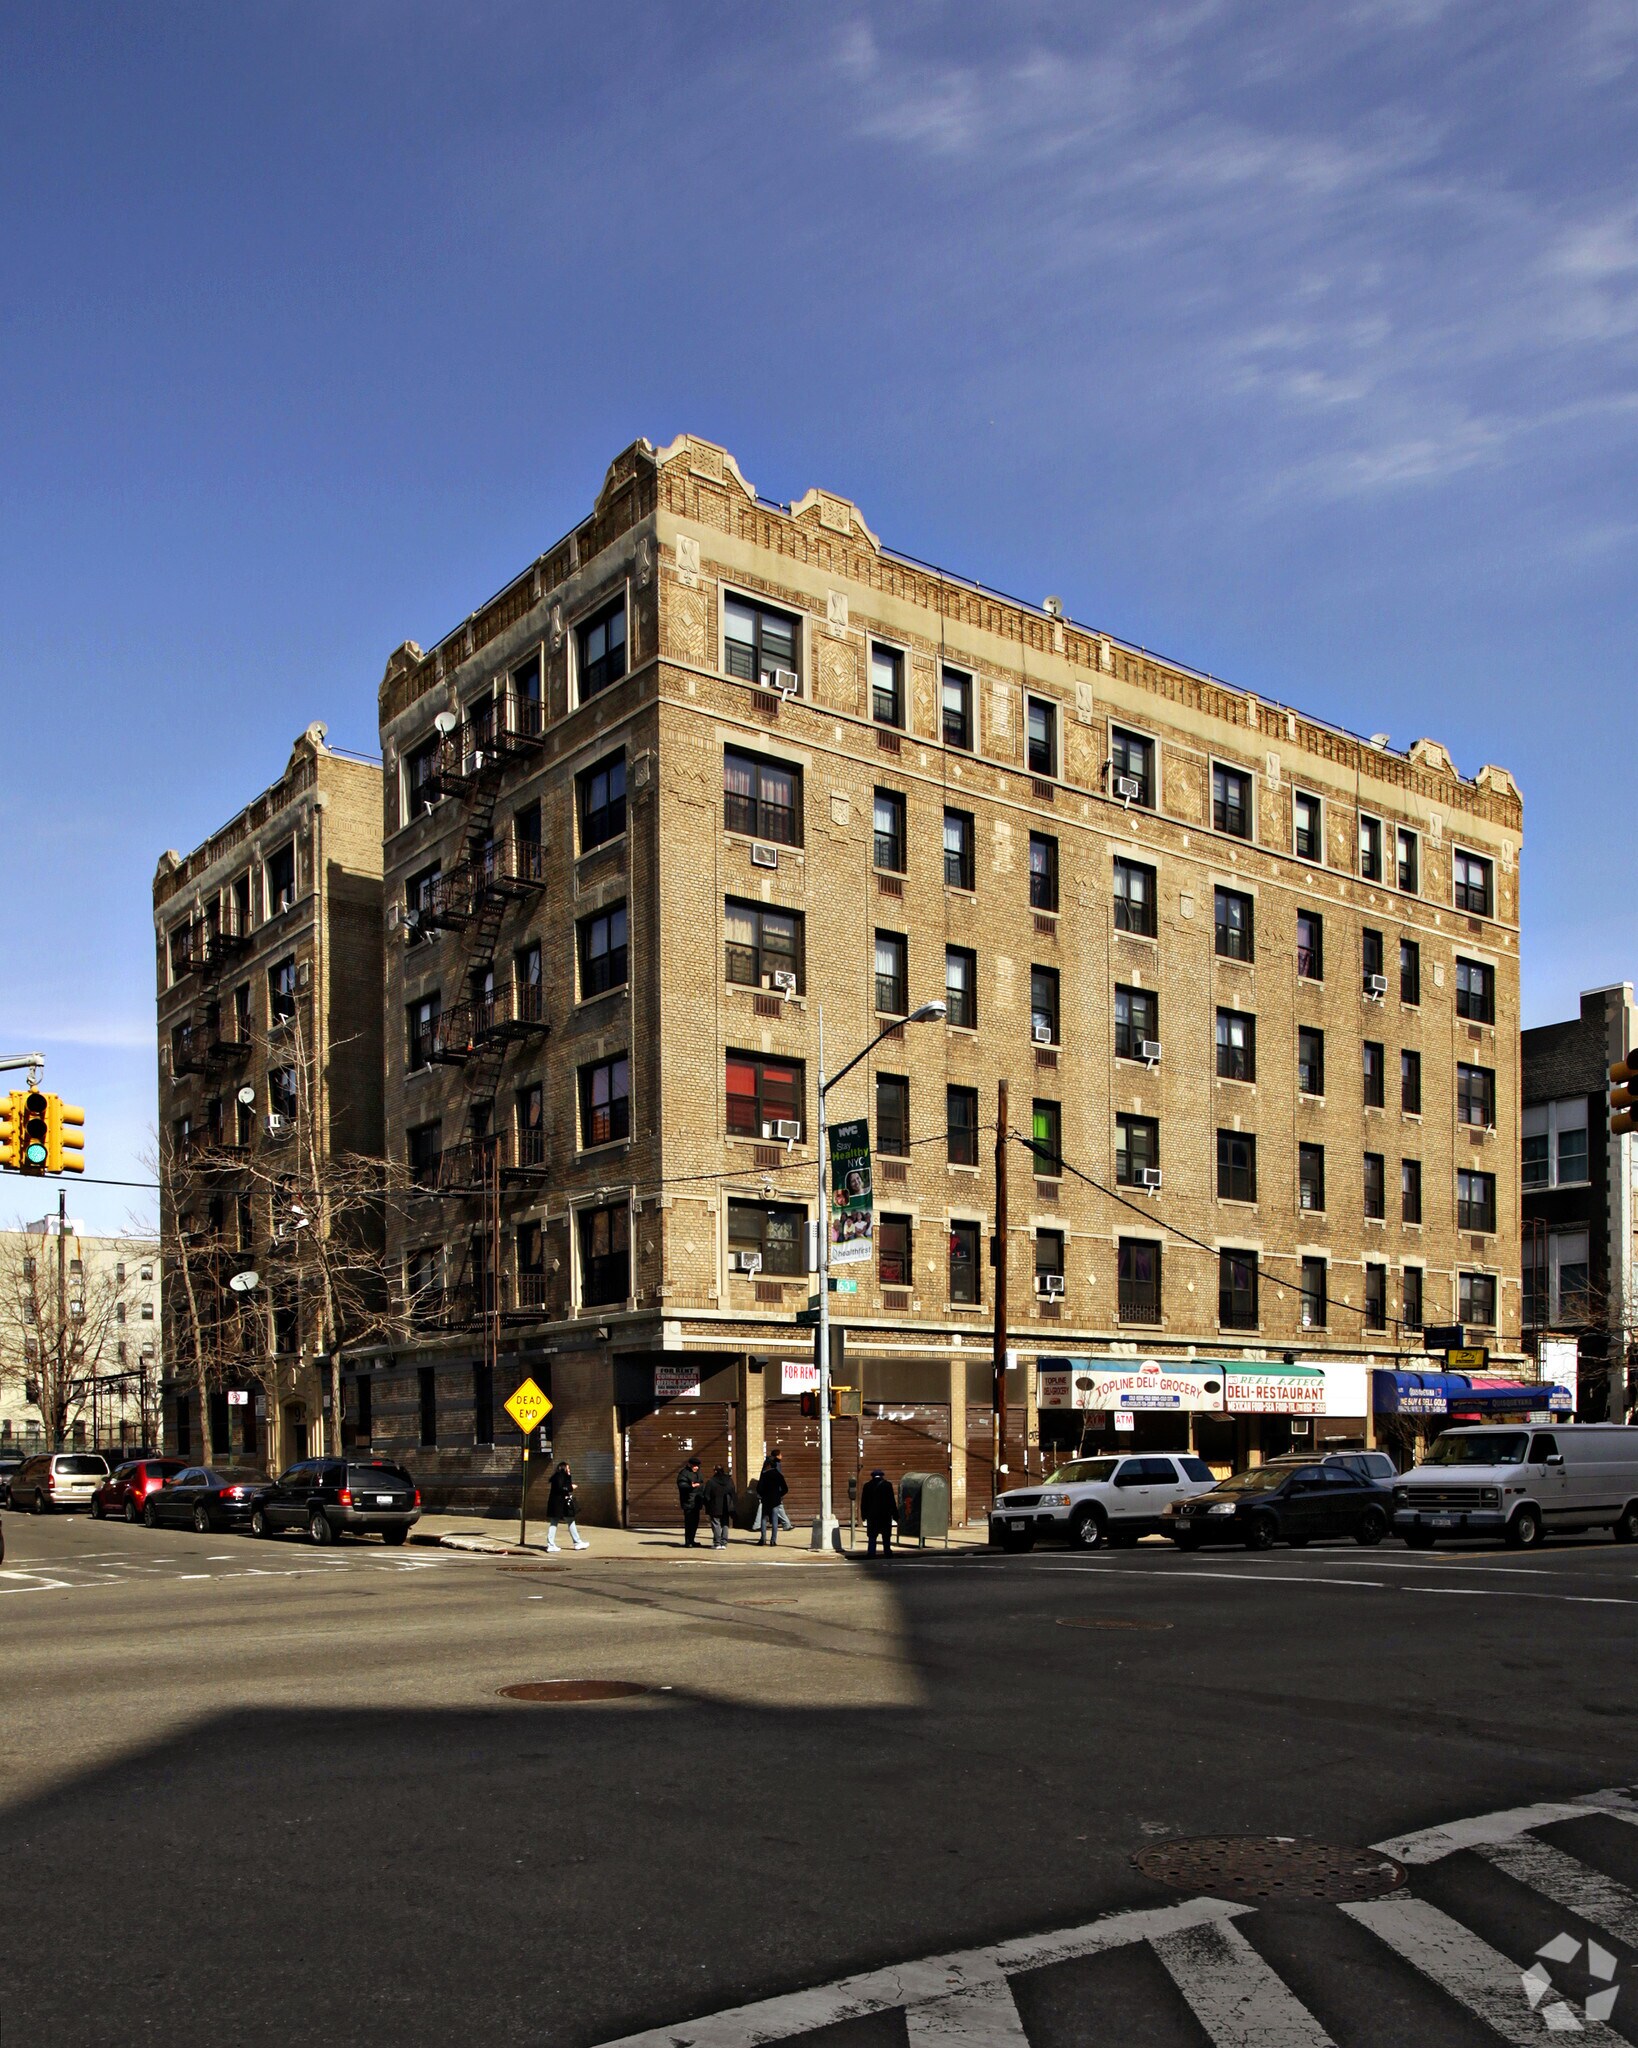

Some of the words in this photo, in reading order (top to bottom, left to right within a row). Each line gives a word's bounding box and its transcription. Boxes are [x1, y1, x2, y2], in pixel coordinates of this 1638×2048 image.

[838, 1125, 859, 1138] NYC
[837, 1142, 852, 1151] Stay
[832, 1148, 868, 1160] Healthy
[848, 1156, 865, 1167] NYC
[838, 1246, 871, 1257] healthfirst
[784, 1365, 799, 1379] FOR
[800, 1366, 817, 1380] RENT
[1045, 1376, 1067, 1384] TOPLINE
[1240, 1376, 1271, 1384] REAL
[1278, 1378, 1324, 1386] AZTECA
[1096, 1377, 1134, 1397] TOPLINE
[1160, 1379, 1202, 1399] GROCERY
[1228, 1385, 1324, 1400] DELI-RESTAURANT
[516, 1395, 542, 1405] DEAD
[1423, 1398, 1433, 1406] SELL
[1434, 1398, 1447, 1406] GOLD
[1228, 1401, 1251, 1411] MEXICAN
[519, 1409, 538, 1418] END
[1086, 1414, 1105, 1424] ATM
[1115, 1415, 1133, 1424] ATM
